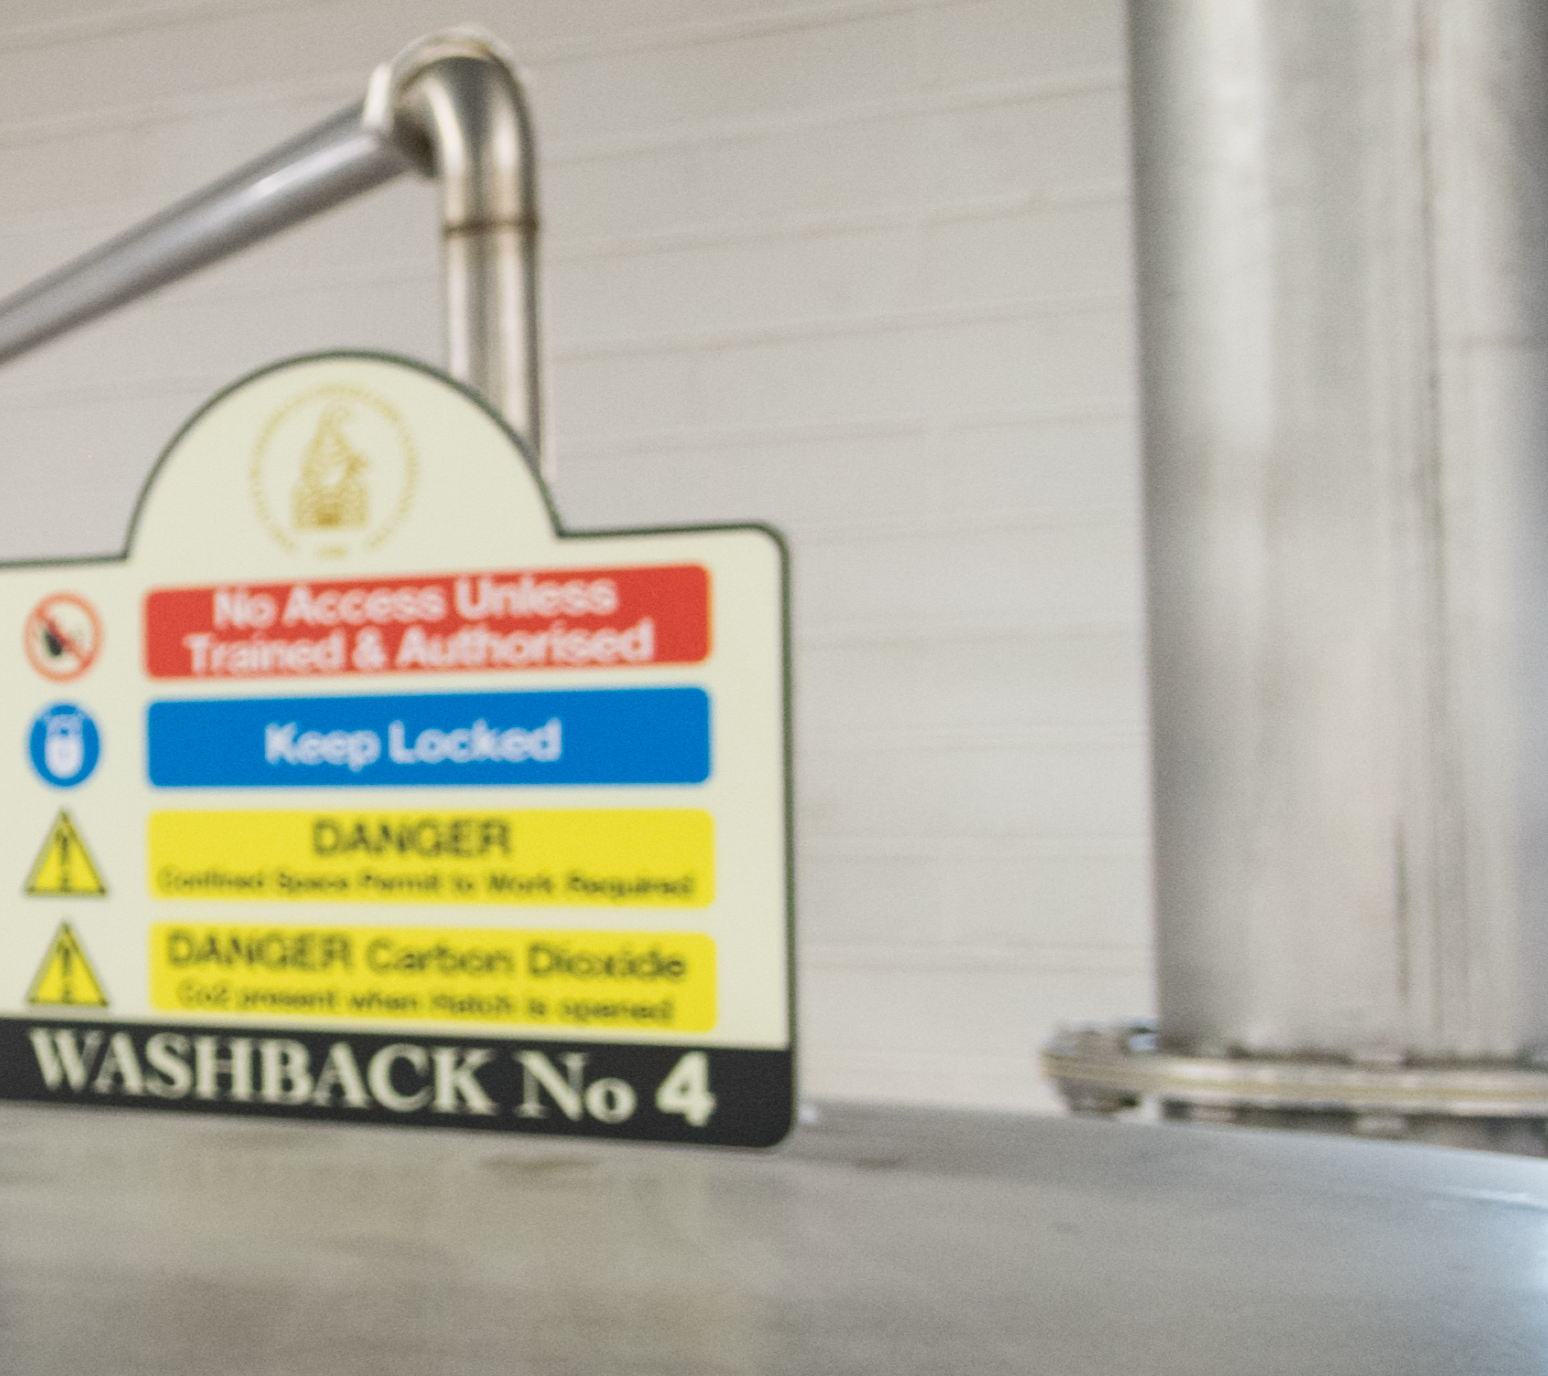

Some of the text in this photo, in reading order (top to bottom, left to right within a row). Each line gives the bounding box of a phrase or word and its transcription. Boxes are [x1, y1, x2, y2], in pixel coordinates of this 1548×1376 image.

[212, 571, 620, 629] No Access Unless
[182, 617, 656, 676] Trained & Authorised
[264, 717, 563, 771] Keep Locked
[311, 816, 513, 859] DANGER
[167, 929, 687, 984] DANGER Carbon Dioxide
[28, 1026, 718, 1129] WASHBACK No 4
